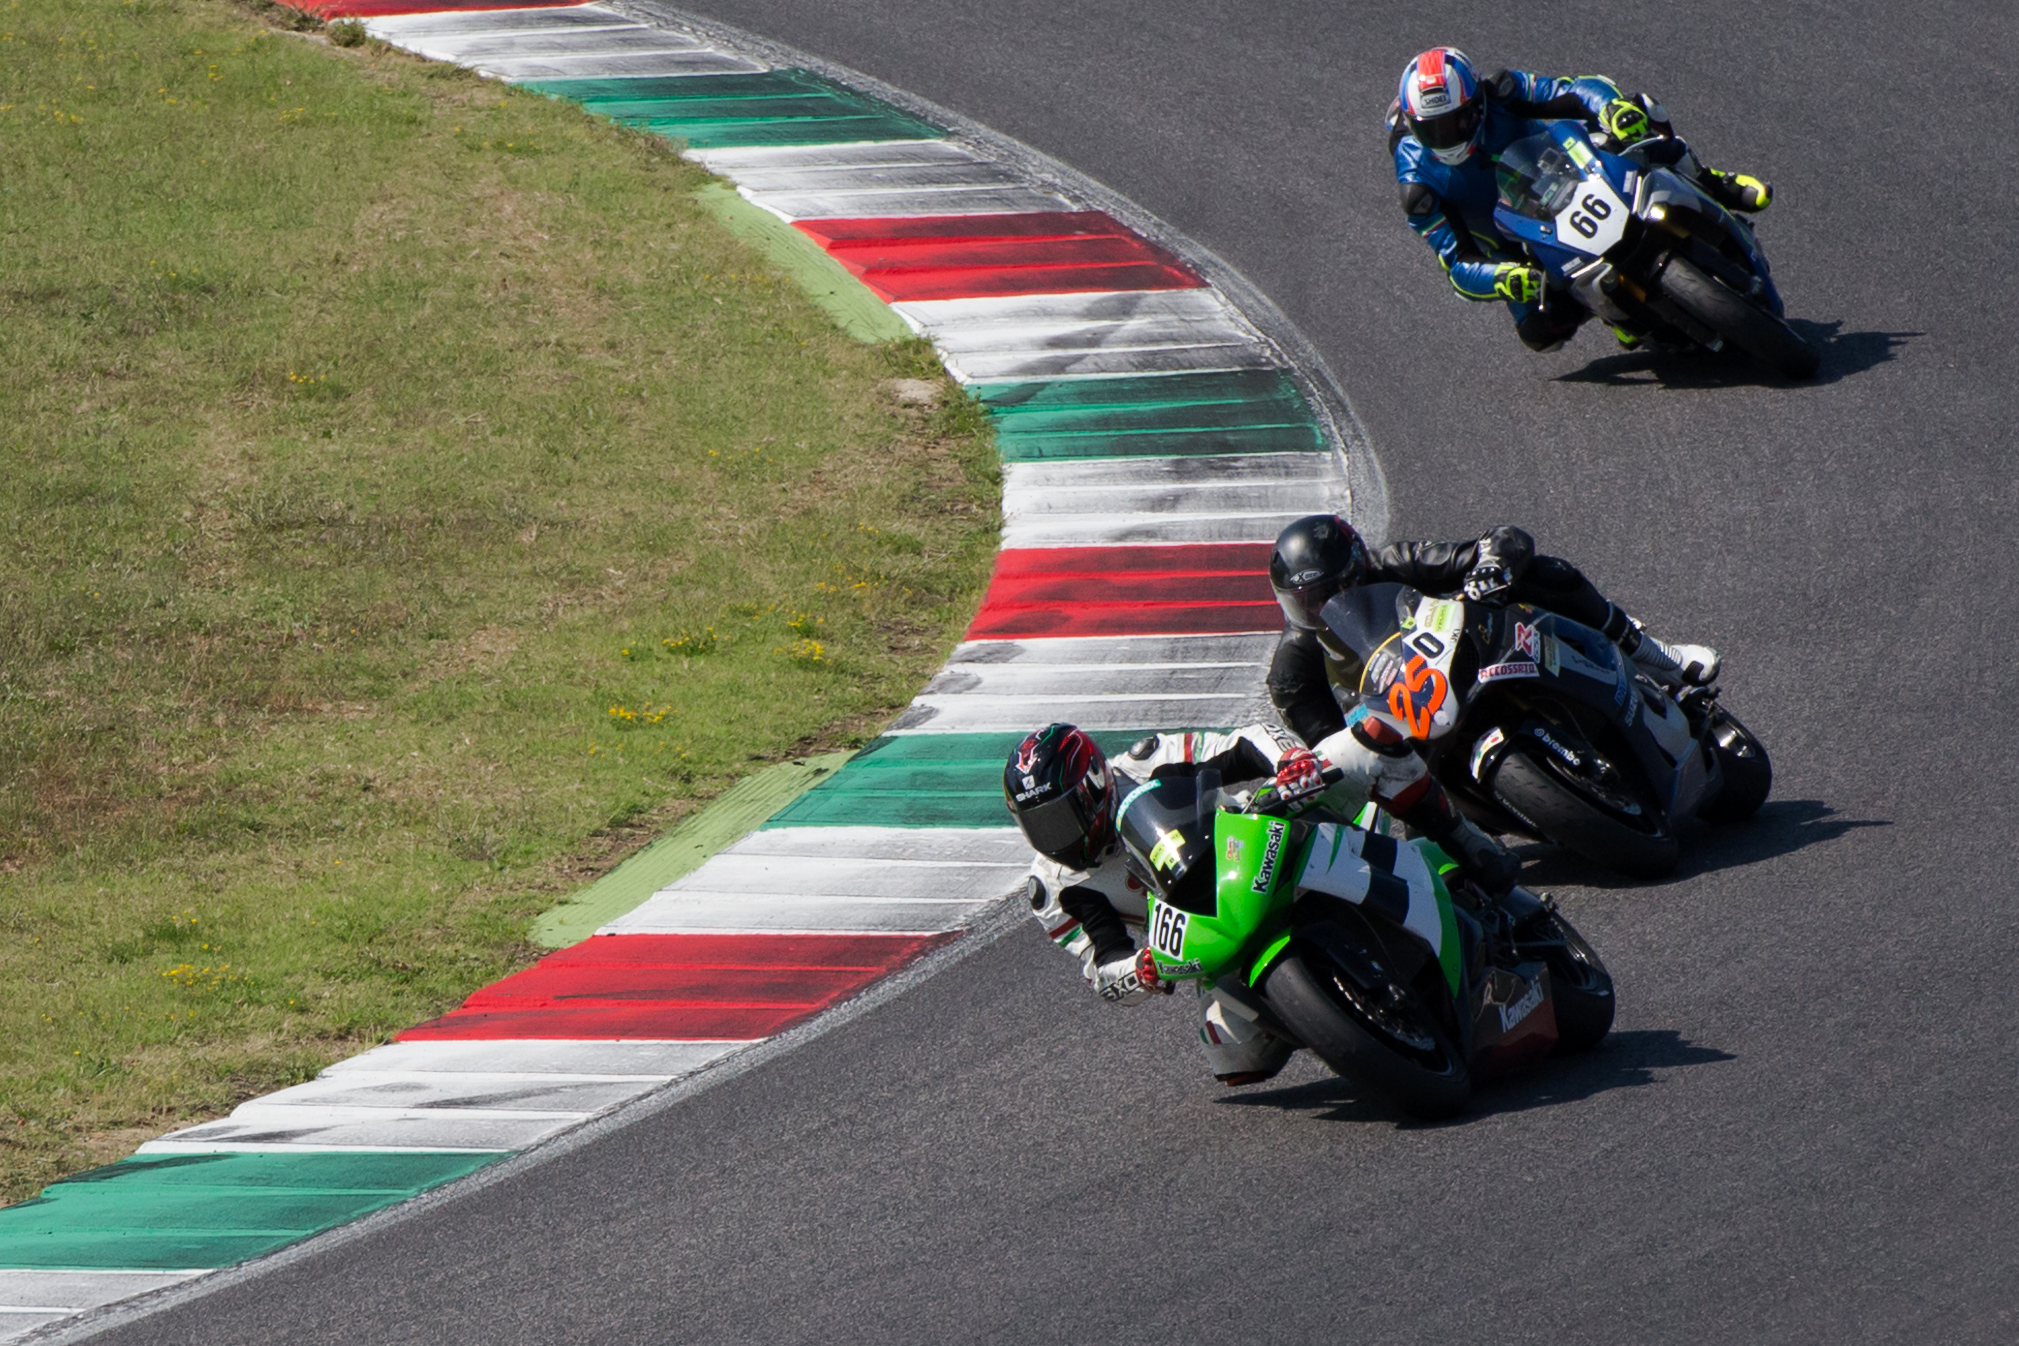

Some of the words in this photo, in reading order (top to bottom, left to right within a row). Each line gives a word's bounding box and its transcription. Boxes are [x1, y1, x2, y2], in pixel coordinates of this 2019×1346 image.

[1570, 194, 1611, 239] 66
[1388, 654, 1447, 741] 25
[1542, 732, 1580, 766] brembo
[1015, 782, 1052, 802] SHARK
[1251, 820, 1286, 894] Kawasaki
[1154, 903, 1186, 957] 166
[1499, 974, 1545, 1033] Kawasaki
